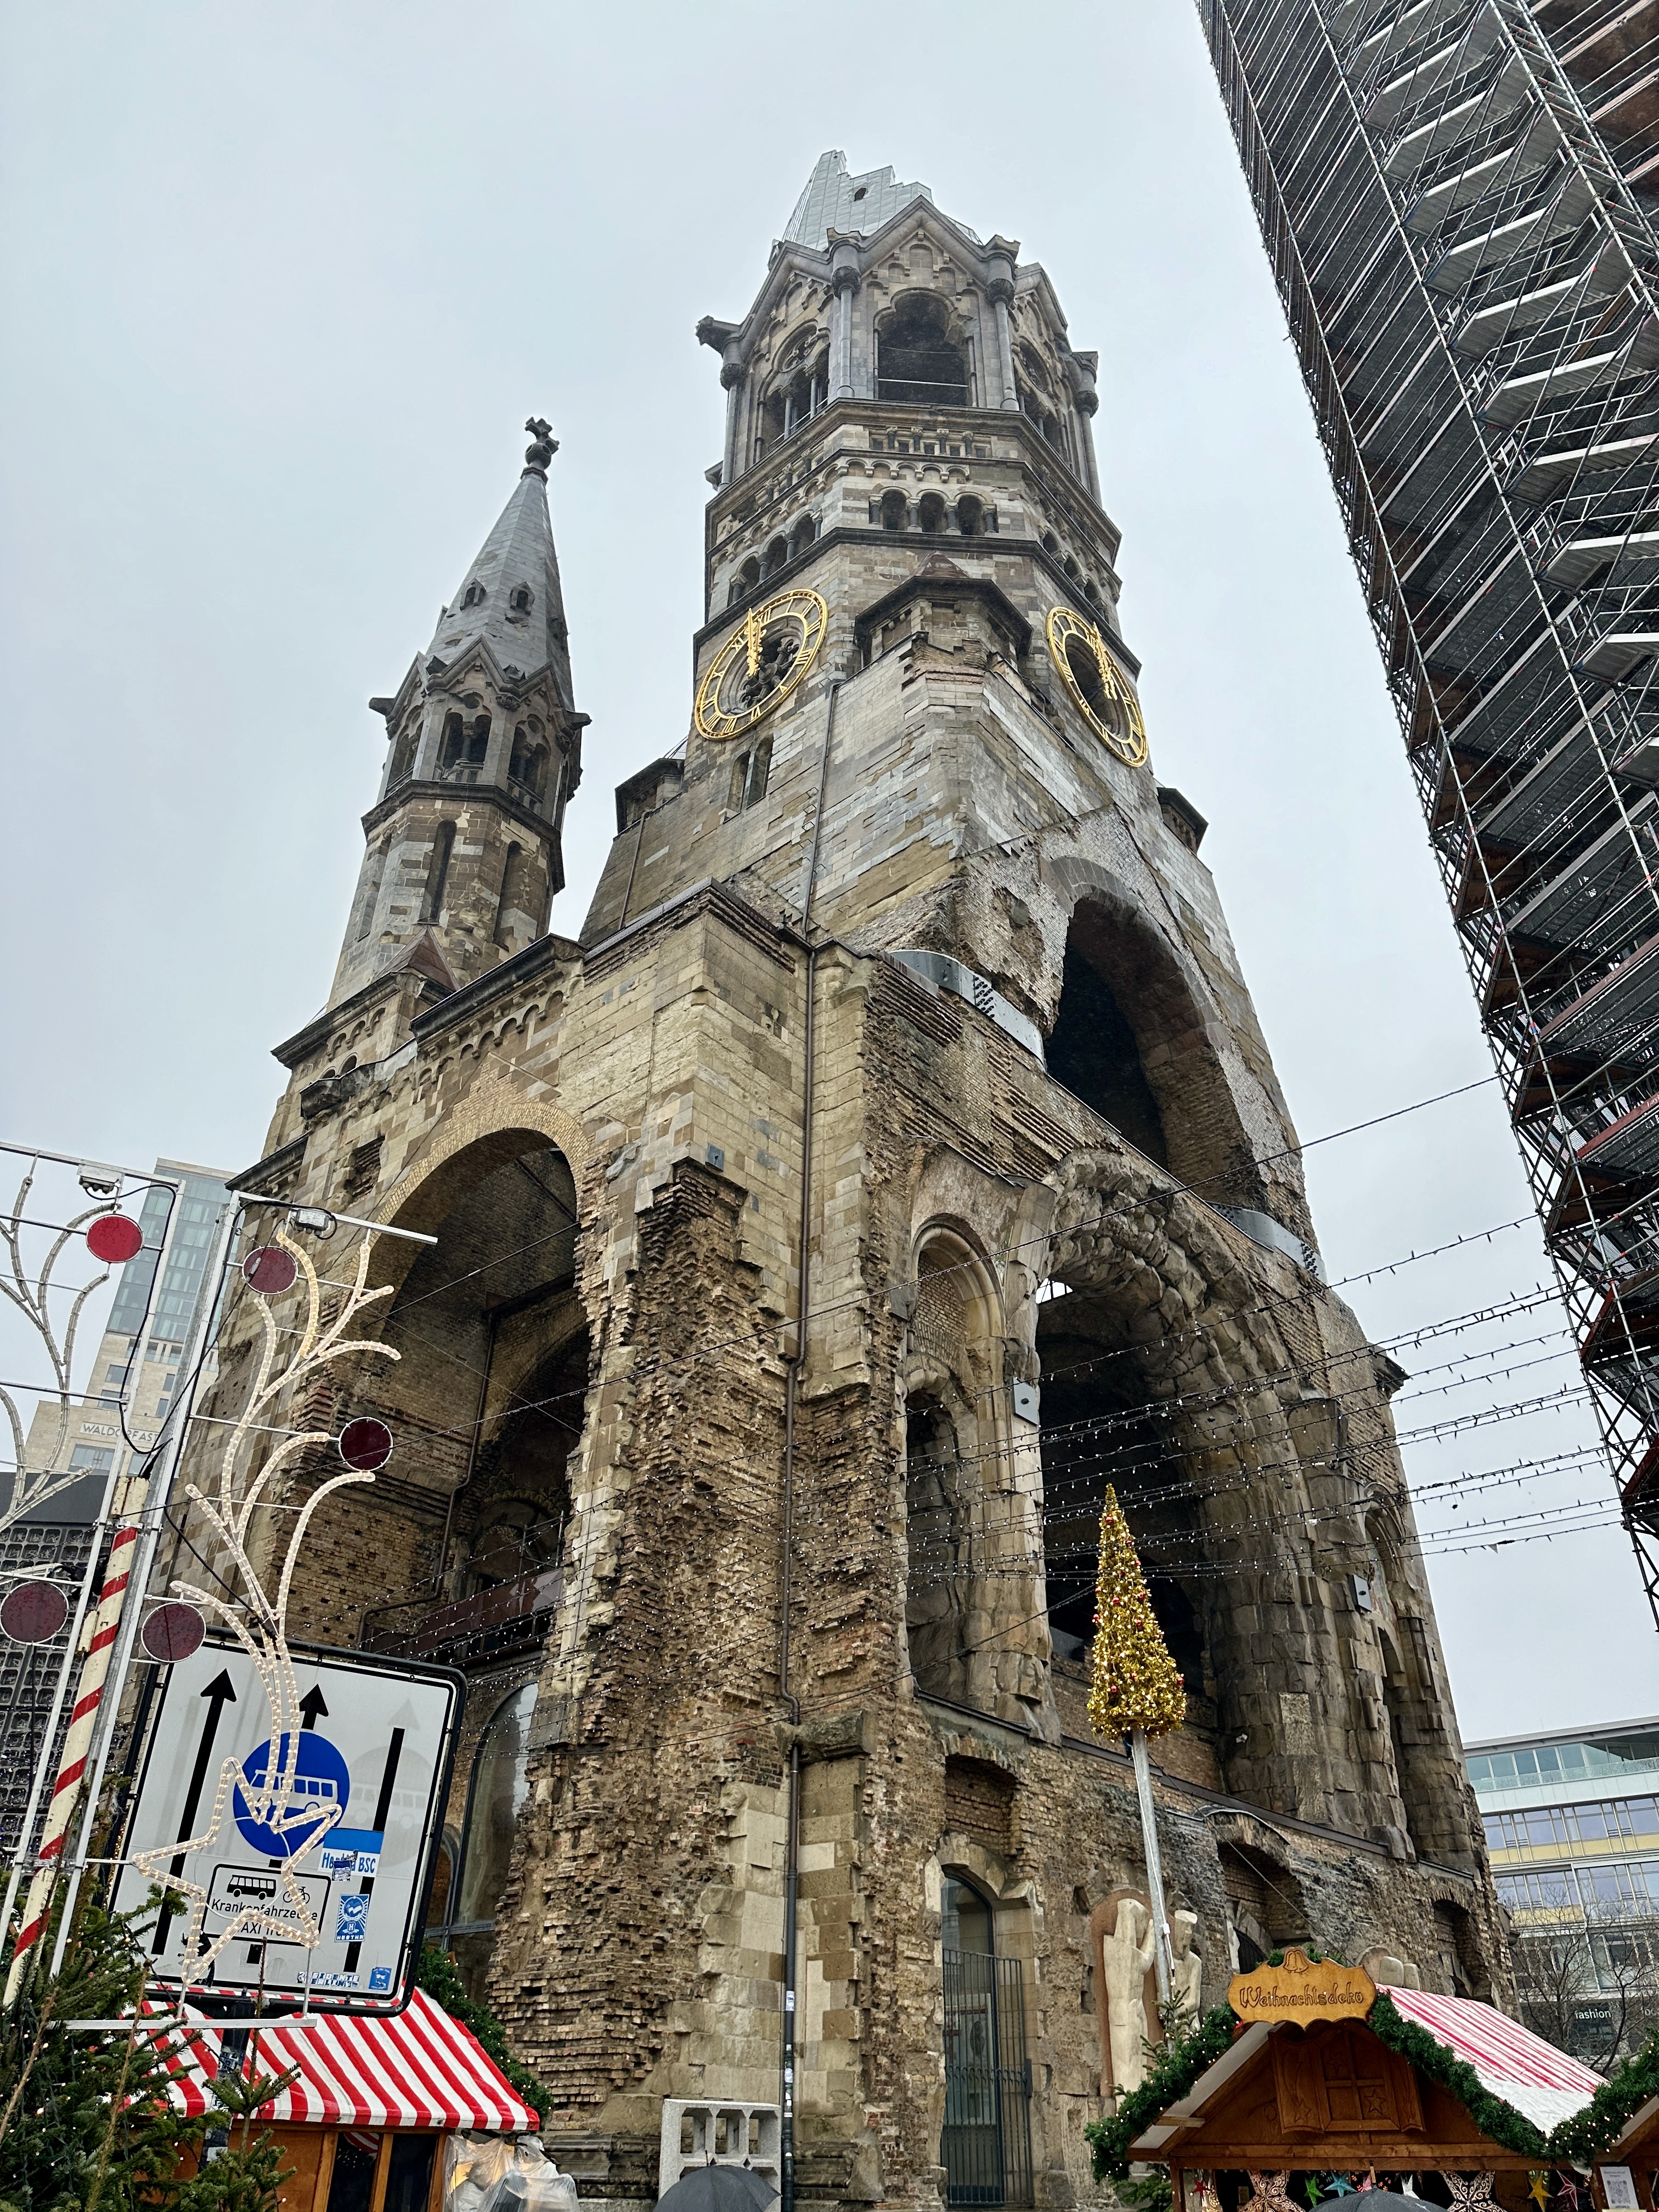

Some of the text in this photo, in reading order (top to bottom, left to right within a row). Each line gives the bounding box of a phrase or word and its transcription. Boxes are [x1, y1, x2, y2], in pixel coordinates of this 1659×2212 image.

[139, 1432, 160, 1442] AST
[358, 1857, 376, 1873] BSC
[236, 1921, 261, 1934] AXI
[1239, 1982, 1364, 2008] Weihnachtsdeko
[1575, 2008, 1611, 2019] fashion
